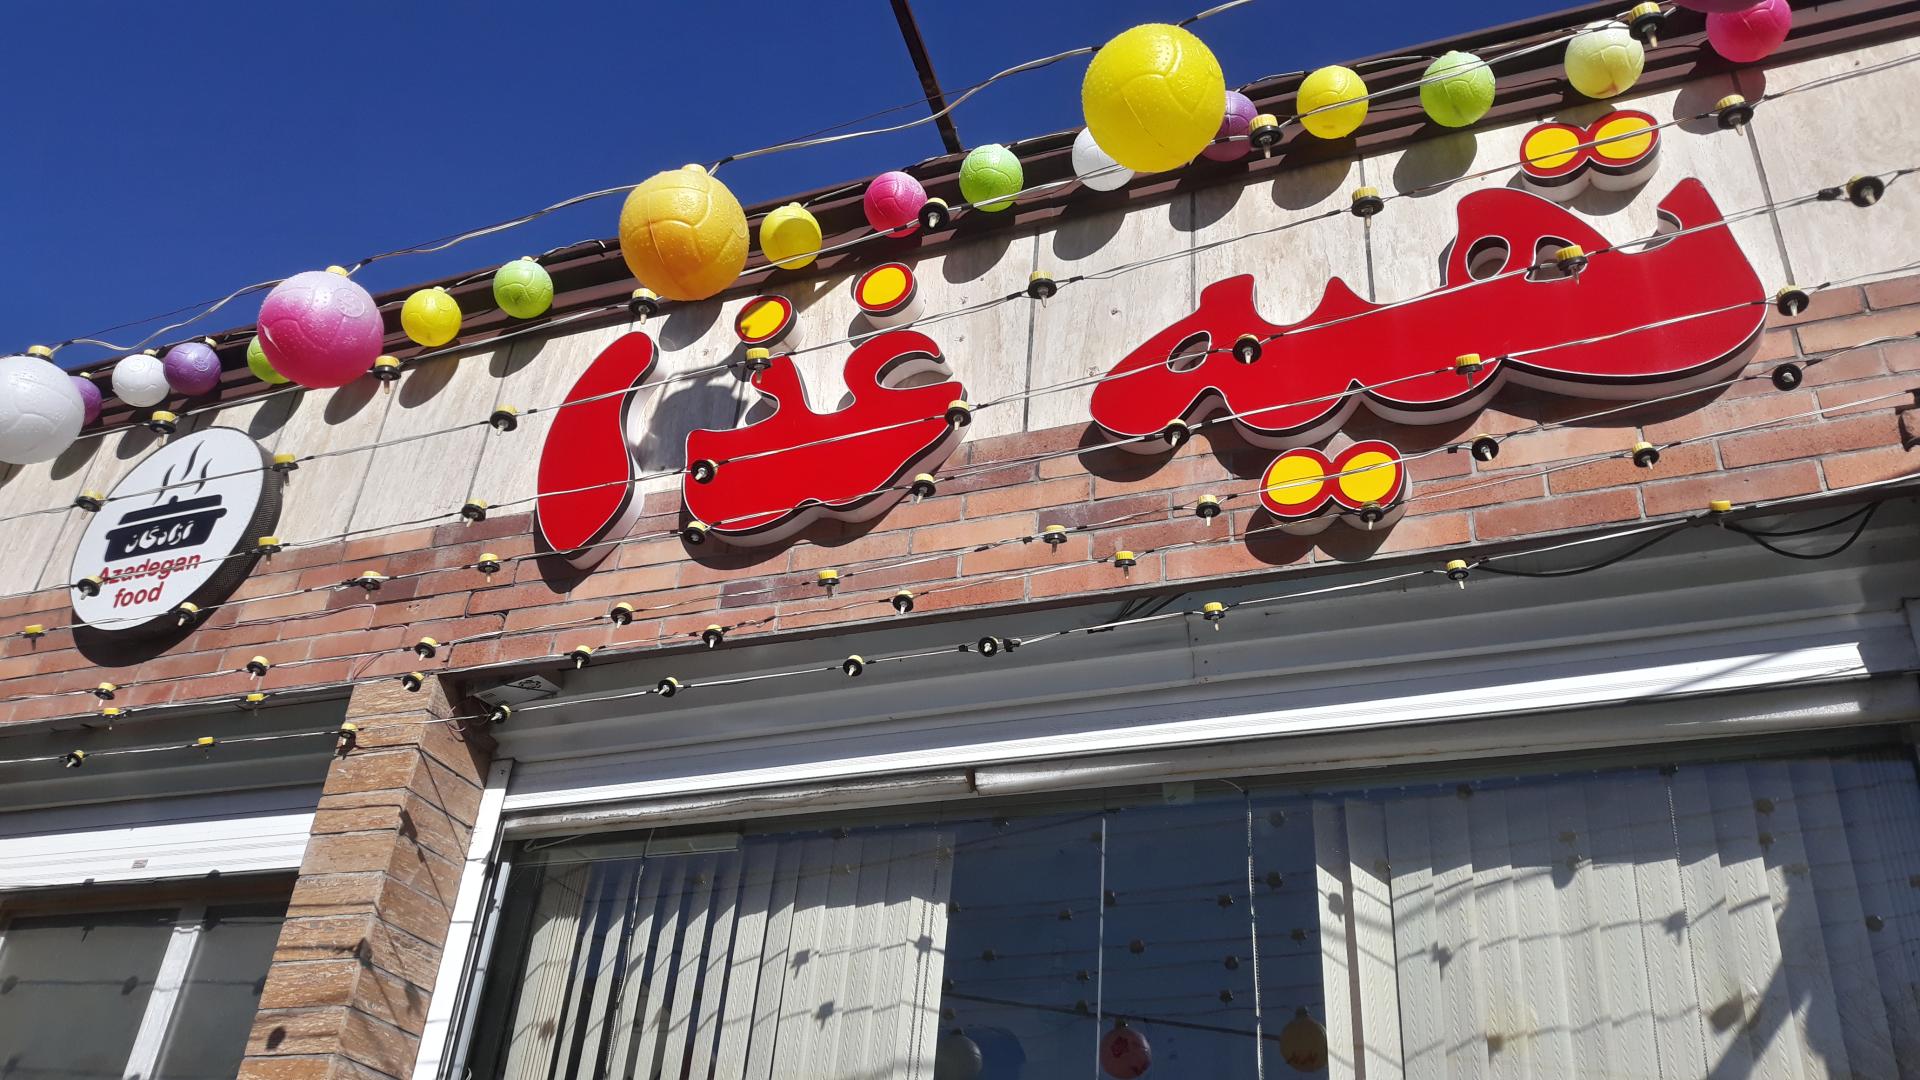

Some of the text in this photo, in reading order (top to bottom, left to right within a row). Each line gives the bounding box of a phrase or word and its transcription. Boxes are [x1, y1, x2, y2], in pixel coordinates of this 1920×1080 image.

[537, 108, 1768, 554] تهیه غذا
[124, 520, 195, 553] آزادگان
[99, 554, 201, 584] Azadegan
[113, 581, 165, 608] food
